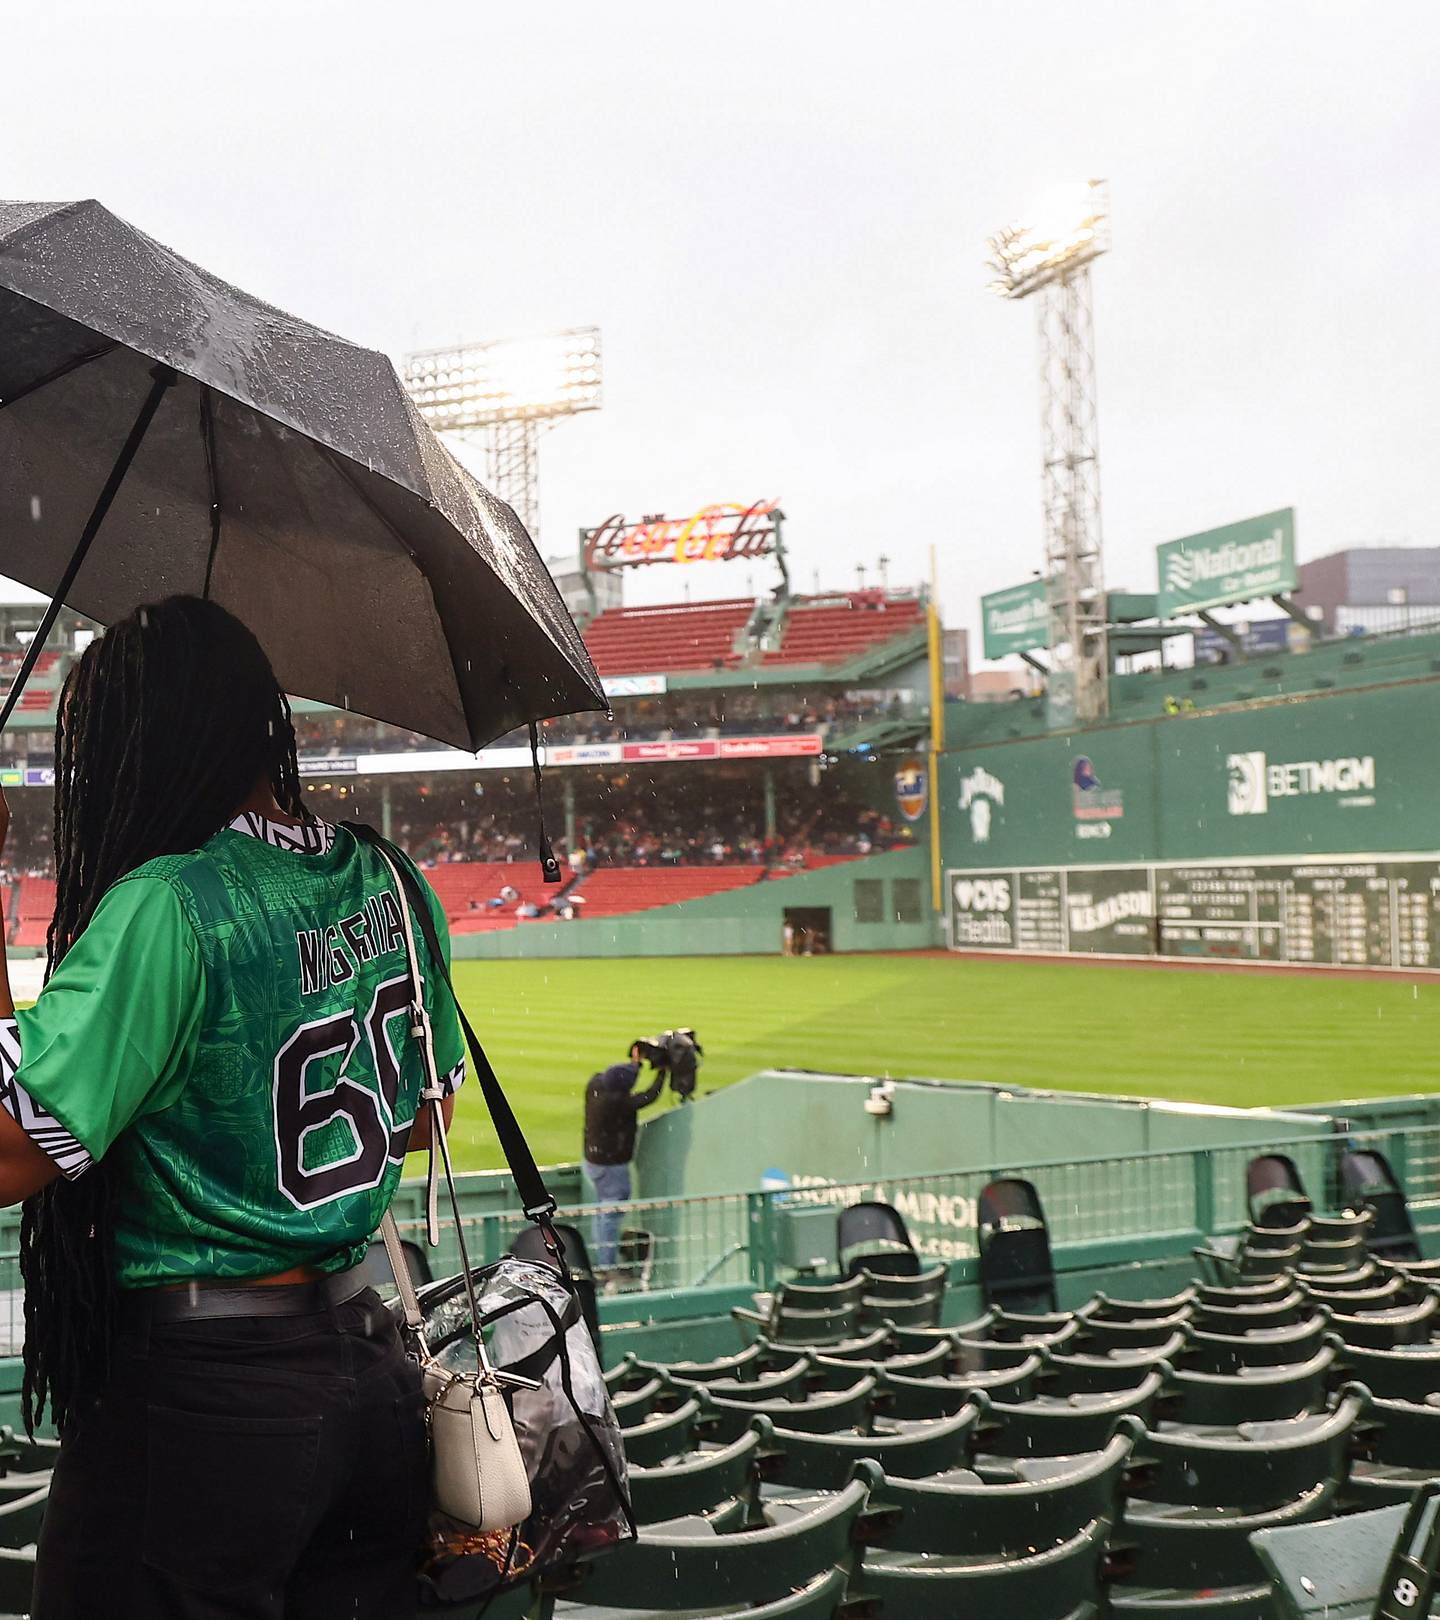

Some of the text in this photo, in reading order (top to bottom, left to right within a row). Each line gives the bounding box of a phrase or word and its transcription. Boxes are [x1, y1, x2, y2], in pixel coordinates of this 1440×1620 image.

[1191, 530, 1283, 581] National
[1267, 756, 1376, 797] BETMGM
[972, 878, 1011, 912] CVS
[1393, 1577, 1419, 1607] 8
